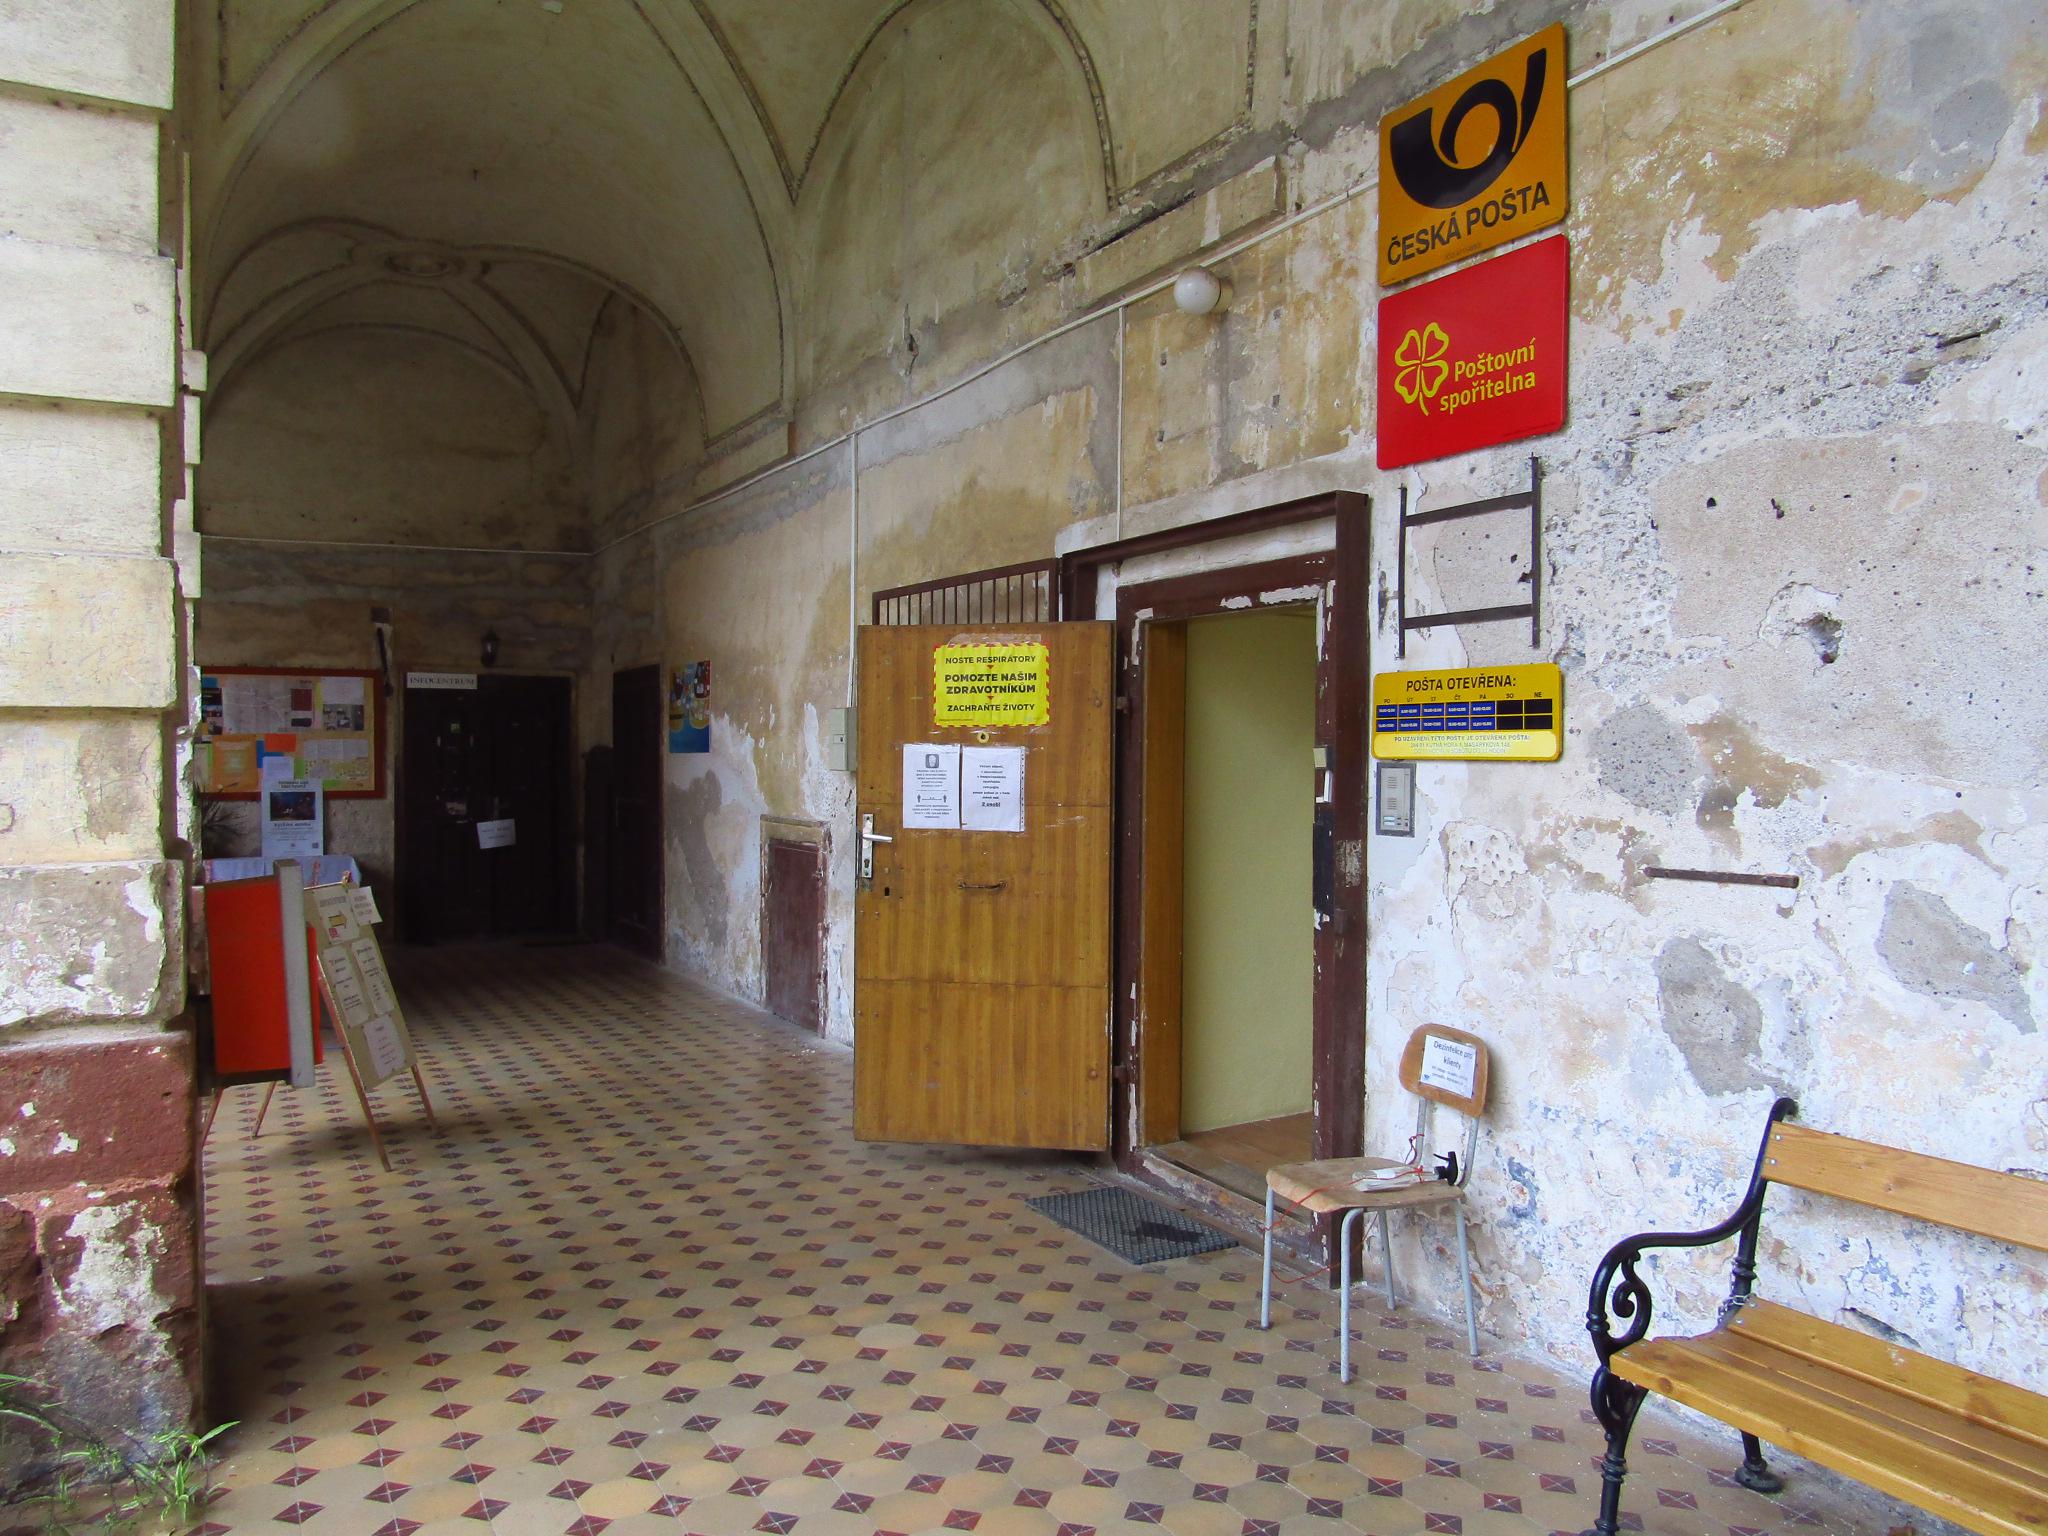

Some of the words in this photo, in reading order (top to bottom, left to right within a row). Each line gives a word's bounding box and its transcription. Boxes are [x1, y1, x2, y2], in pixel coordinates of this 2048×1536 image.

[1387, 211, 1462, 266] ČESKÁ
[1466, 181, 1550, 235] POŠTA
[1454, 336, 1536, 382] Poštovní
[1439, 371, 1536, 415] spořitelna
[945, 656, 974, 664] NOSTE
[944, 673, 998, 683] POMOZTE
[1000, 671, 1037, 682] NAŠIM
[1406, 677, 1443, 692] POŠTA
[1446, 673, 1516, 690] OTEVŘENA:
[946, 682, 1036, 695] ZDRAVOTNÍKŮM
[947, 702, 1001, 712] ZACHRAŇTE
[1003, 702, 1035, 711] ŽIVOTY
